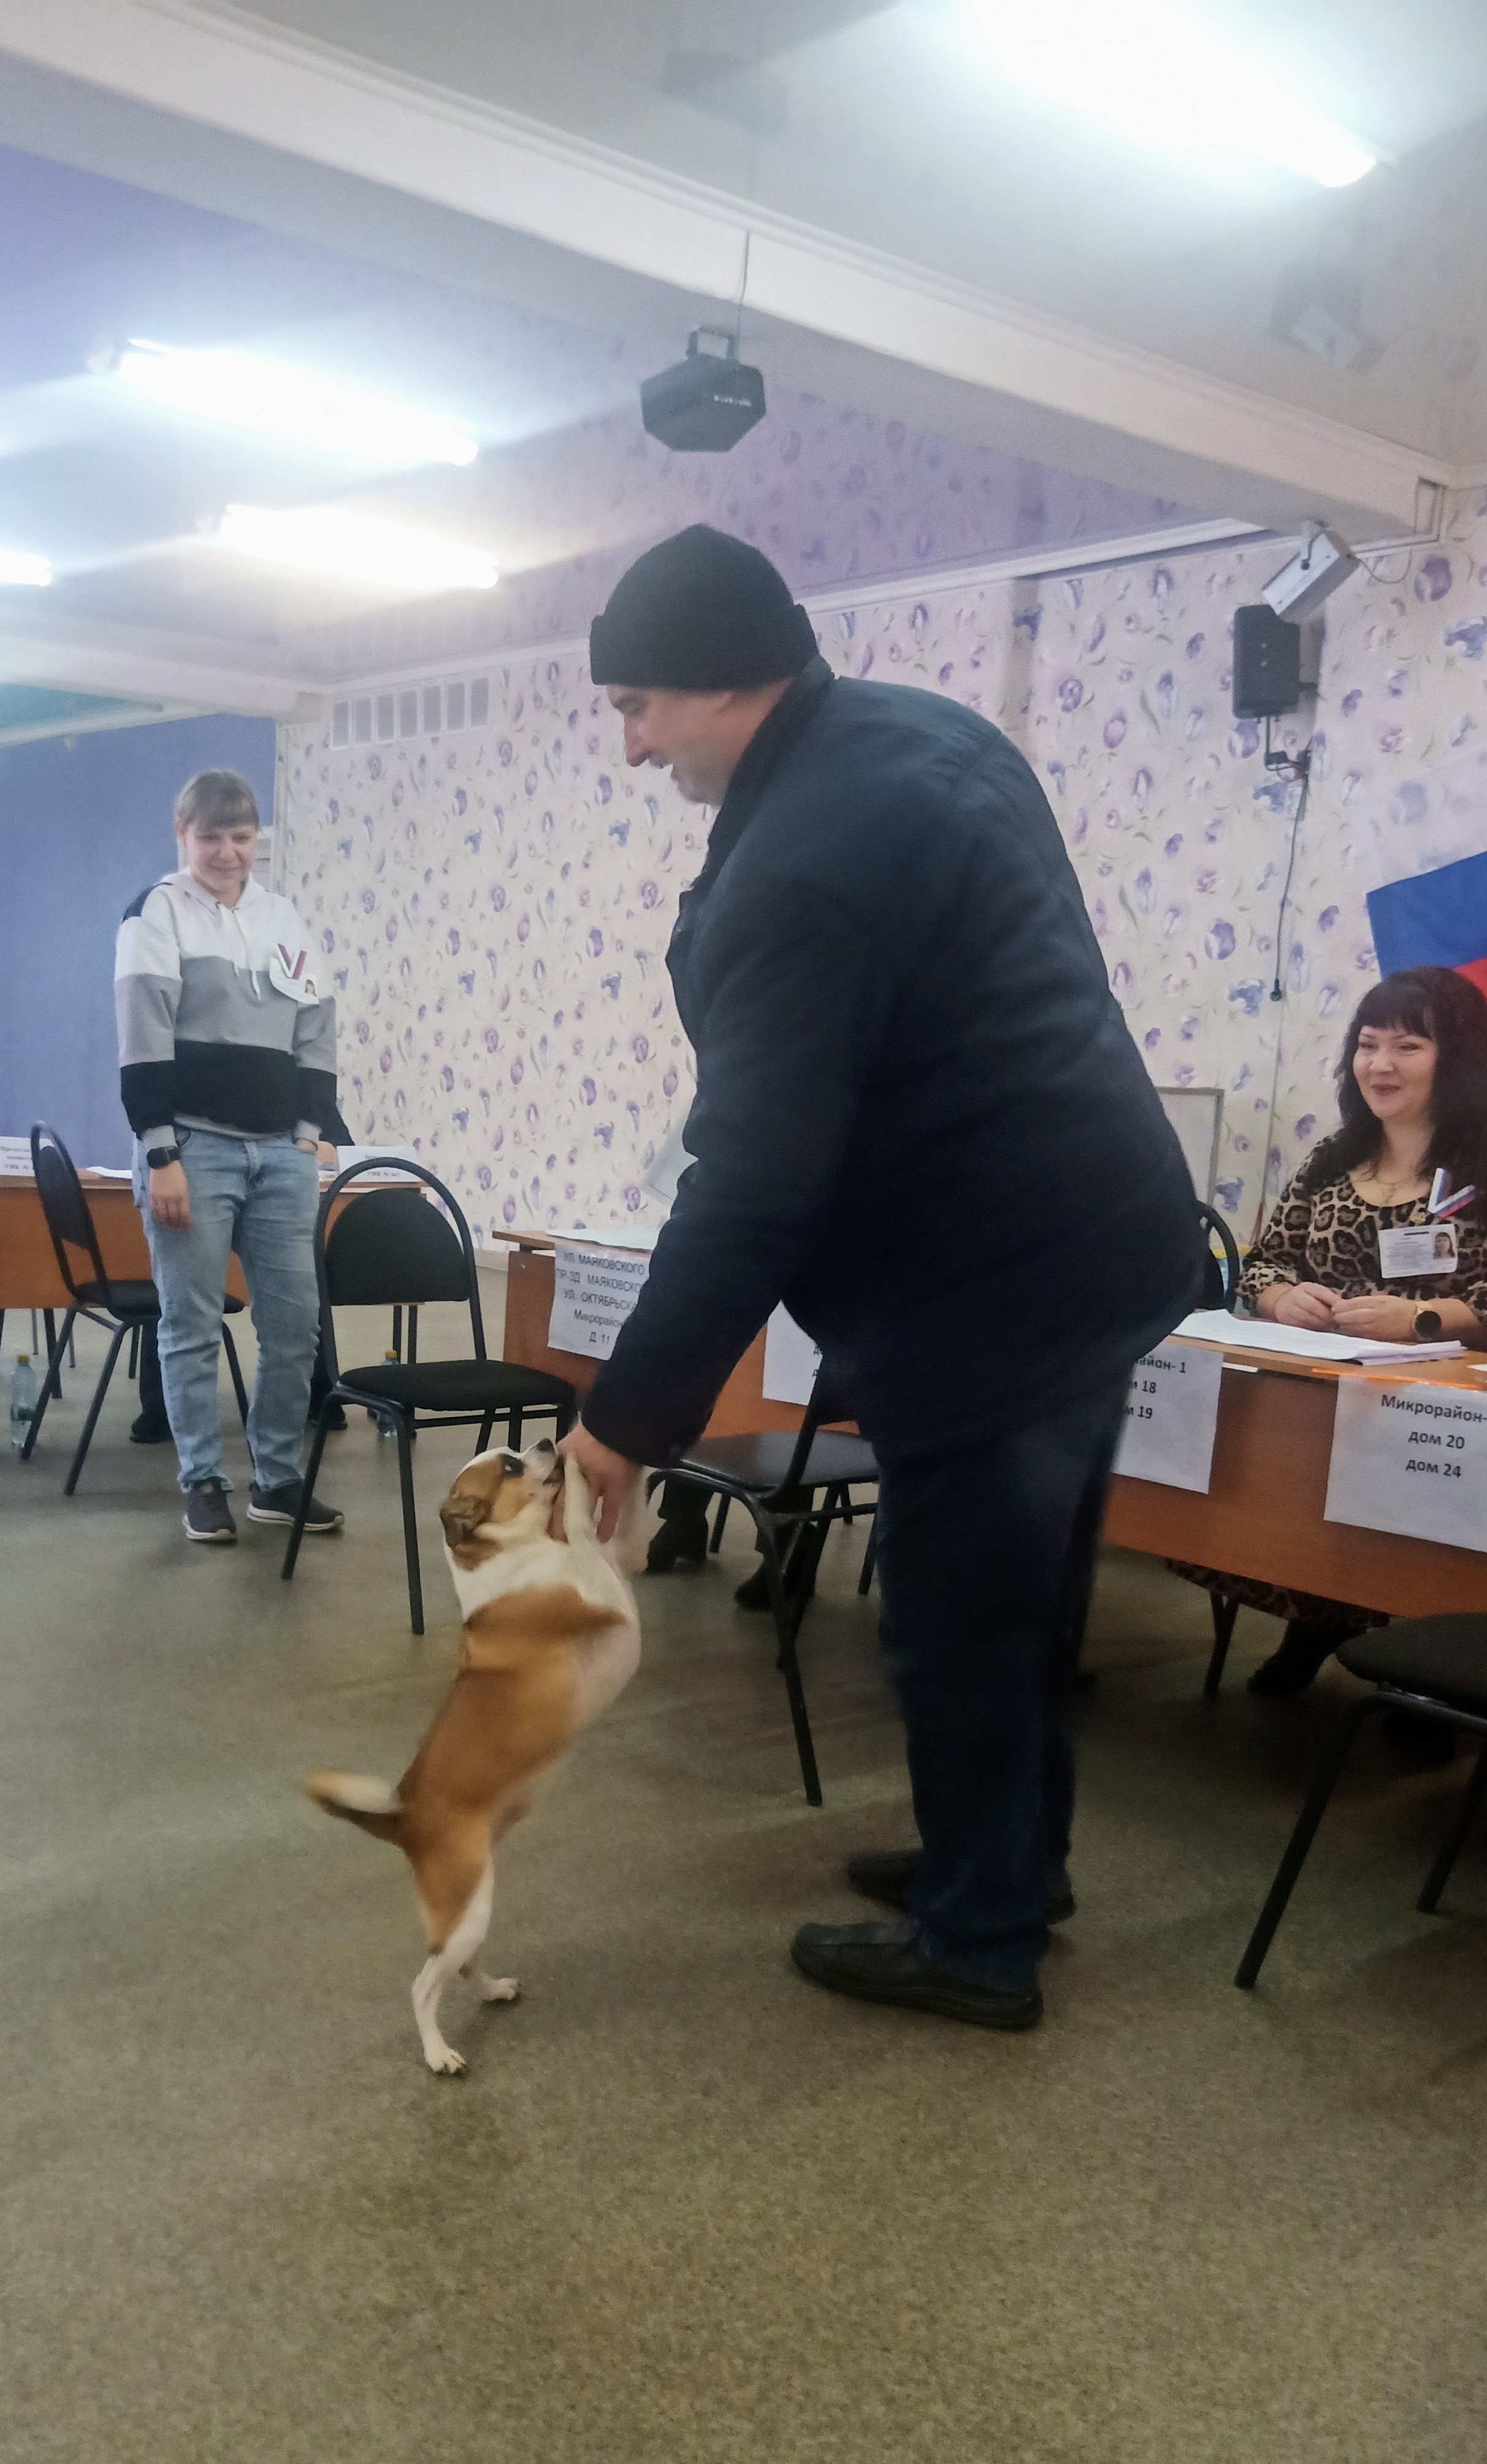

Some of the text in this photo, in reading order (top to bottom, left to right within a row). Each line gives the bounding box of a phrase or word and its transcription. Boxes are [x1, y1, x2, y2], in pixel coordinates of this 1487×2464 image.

[578, 1254, 645, 1275] МАЯКОВСКОГО
[587, 1273, 643, 1294] МАЯКОВСКО
[602, 1334, 610, 1345] 11
[1142, 1380, 1156, 1394] 18
[1137, 1406, 1153, 1419] 19
[1408, 1432, 1465, 1449] дом 20
[1405, 1460, 1462, 1478] дом 24
